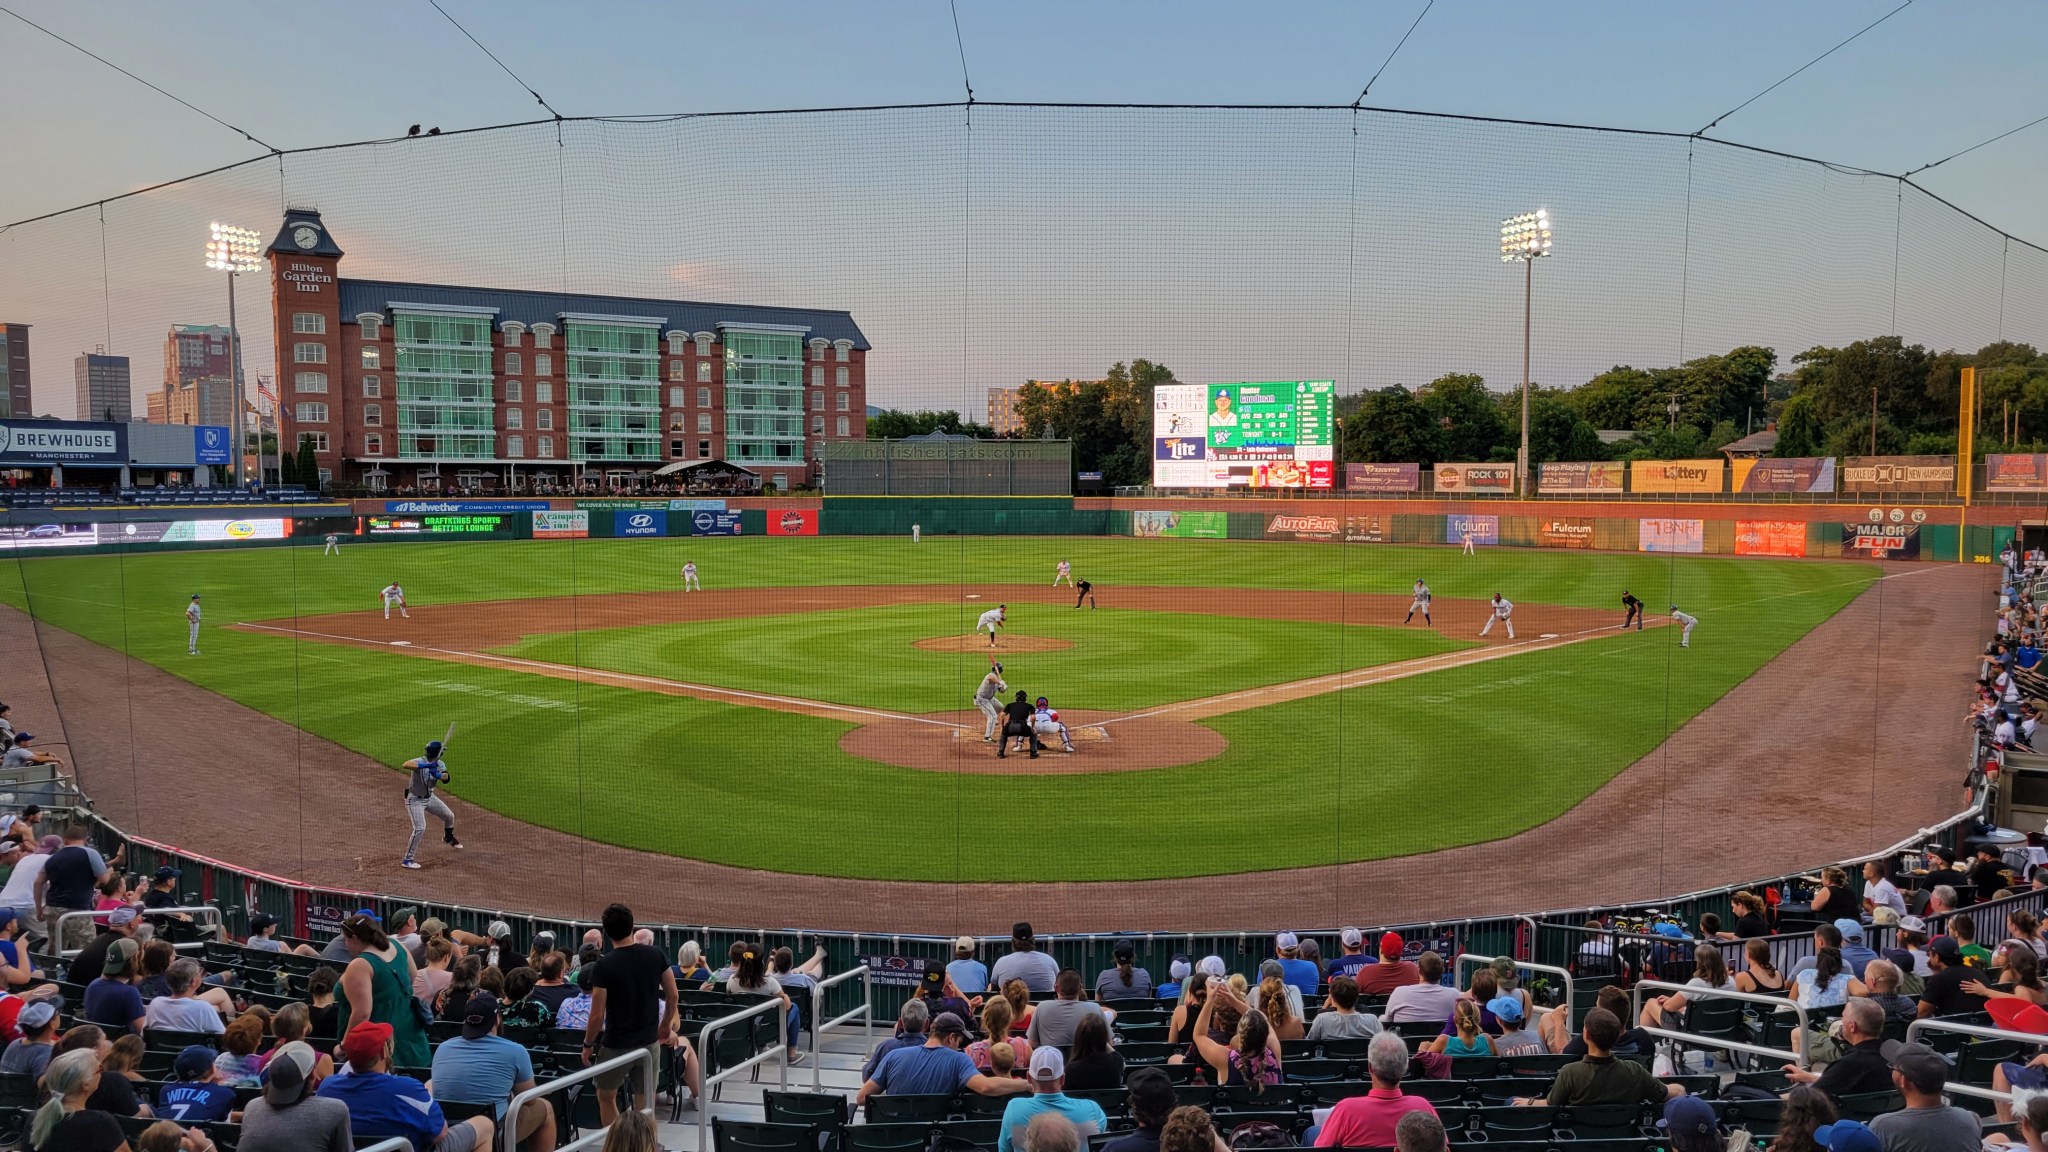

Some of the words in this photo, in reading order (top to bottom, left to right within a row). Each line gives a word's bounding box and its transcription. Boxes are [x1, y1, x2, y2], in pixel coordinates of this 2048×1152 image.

[291, 263, 323, 272] Hilton
[283, 271, 332, 283] Garden
[296, 282, 320, 292] Inn
[17, 434, 112, 447] BREWHOUSE
[1171, 443, 1196, 459] Lite
[1561, 464, 1585, 472] Playing
[1467, 471, 1490, 479] ROCK
[1495, 471, 1508, 479] 101
[1845, 468, 1865, 480] BUCKLE
[1866, 468, 1875, 479] UP
[1909, 468, 1922, 479] NEW
[1923, 468, 1953, 479] HAMPSHIRE
[409, 502, 460, 512] Bellwether
[425, 517, 471, 525] DRAFTKINGS
[473, 516, 501, 525] SPORTS
[547, 513, 586, 521] campers
[466, 524, 494, 532] LOUNGE
[1455, 519, 1489, 532] fidium
[1552, 522, 1591, 533] Fulcrum
[1857, 525, 1905, 536] MAJOR
[1858, 537, 1902, 547] FUN
[1974, 555, 1990, 563] 306
[1430, 940, 1438, 950] 110
[870, 957, 881, 967] 108
[913, 960, 925, 970] 109
[881, 977, 896, 985] STAND
[166, 1088, 196, 1104] WITT
[192, 1089, 211, 1105] JR.
[171, 1104, 190, 1120] 7
